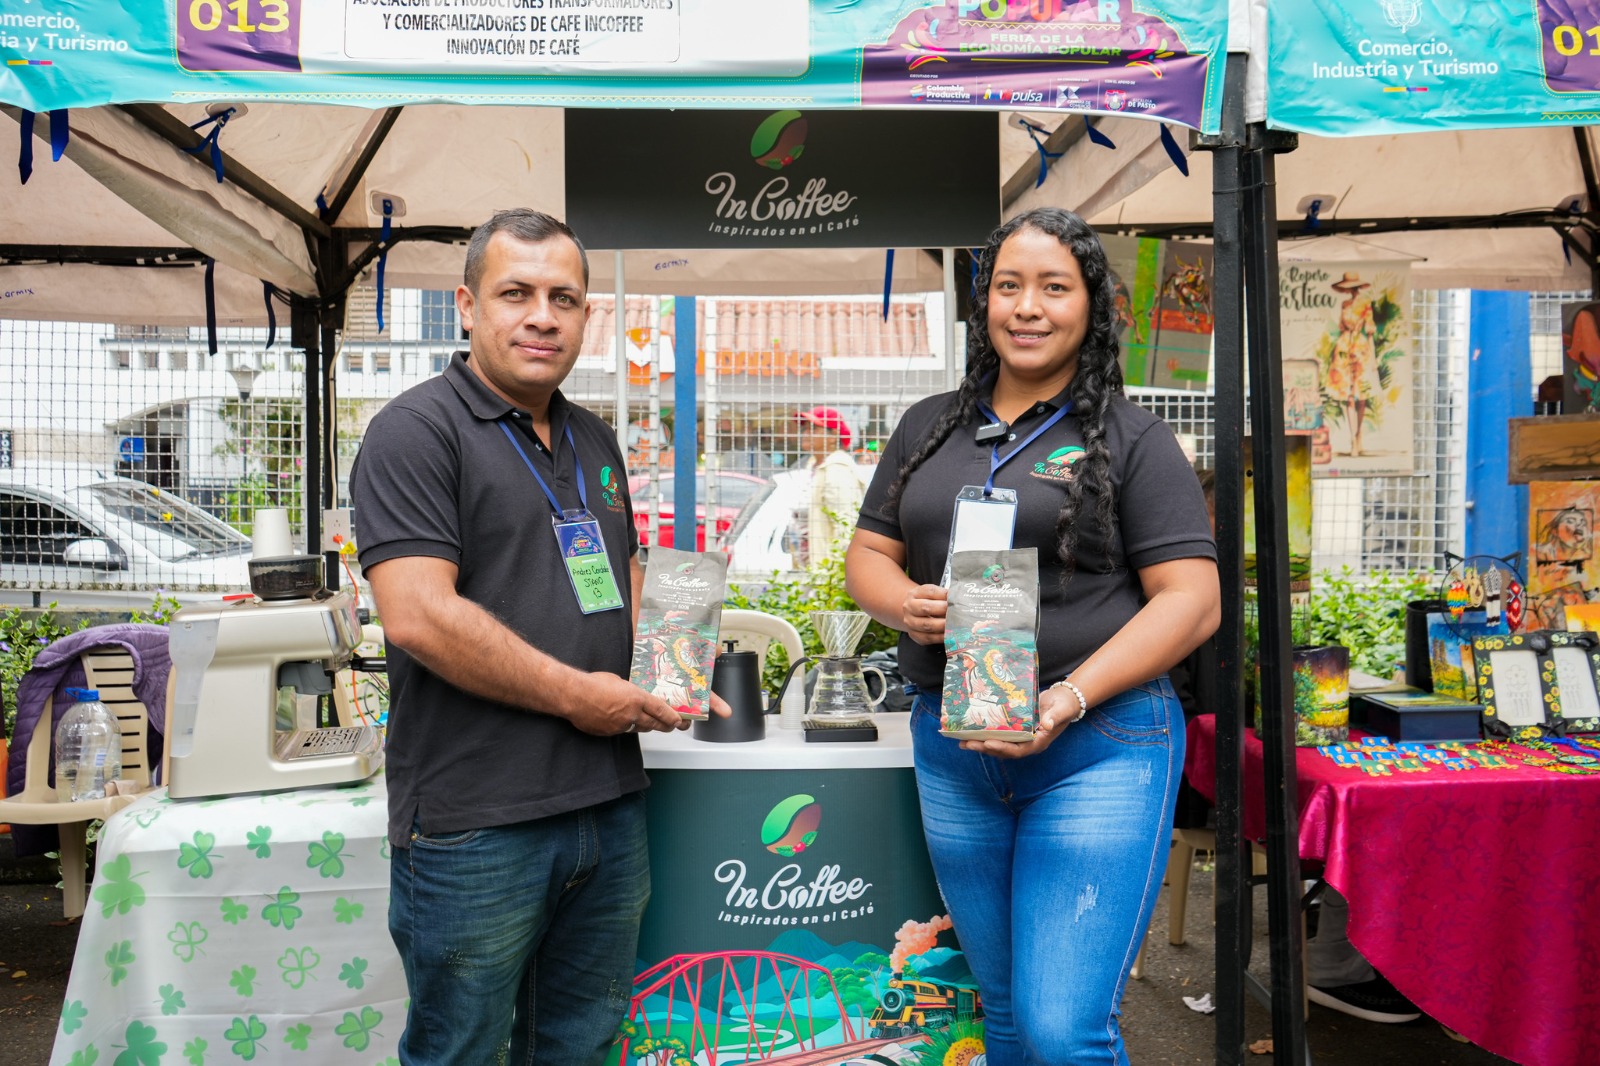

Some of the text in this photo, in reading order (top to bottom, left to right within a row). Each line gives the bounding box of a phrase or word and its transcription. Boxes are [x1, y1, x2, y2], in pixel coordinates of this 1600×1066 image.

[189, 0, 290, 32] 013
[383, 13, 644, 33] Y COMERCIALIZADORES DE CAFE INCOFFEE
[26, 36, 39, 52] y
[44, 33, 129, 52] Turismo
[447, 34, 580, 55] INNOVACIÓN DE CAFÉ
[959, 40, 1122, 57] ECONOMÍA POPULAR
[991, 33, 1085, 44] FERIA DE LA
[1358, 38, 1453, 57] Comercio,
[1313, 59, 1499, 80] Industria y Turismo
[926, 91, 970, 99] Productiva
[705, 172, 858, 221] In Coffee
[708, 214, 860, 237] Inspirados en el Café
[1280, 283, 1337, 311] artica
[714, 859, 873, 910] In Coffee
[718, 902, 874, 926] Inspirados en el Café
